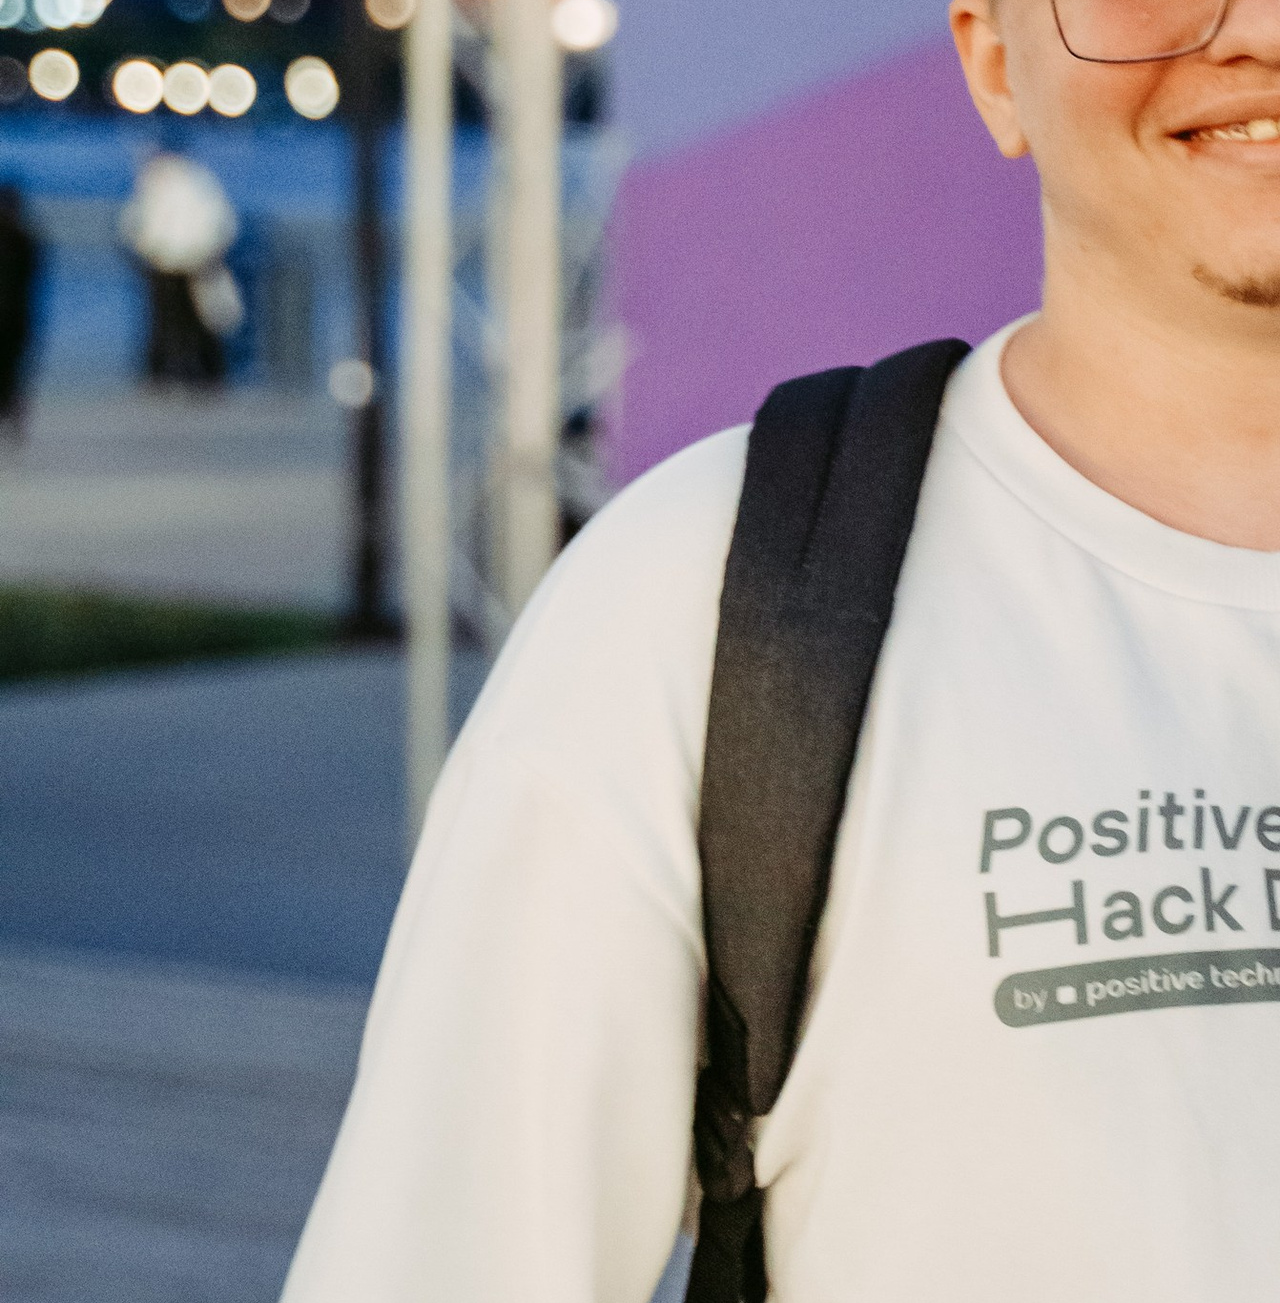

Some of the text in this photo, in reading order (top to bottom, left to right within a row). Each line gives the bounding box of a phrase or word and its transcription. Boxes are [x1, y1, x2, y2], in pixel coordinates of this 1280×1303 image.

[984, 866, 1244, 958] Hack
[1013, 986, 1048, 1013] by
[1085, 965, 1205, 1007] positive
